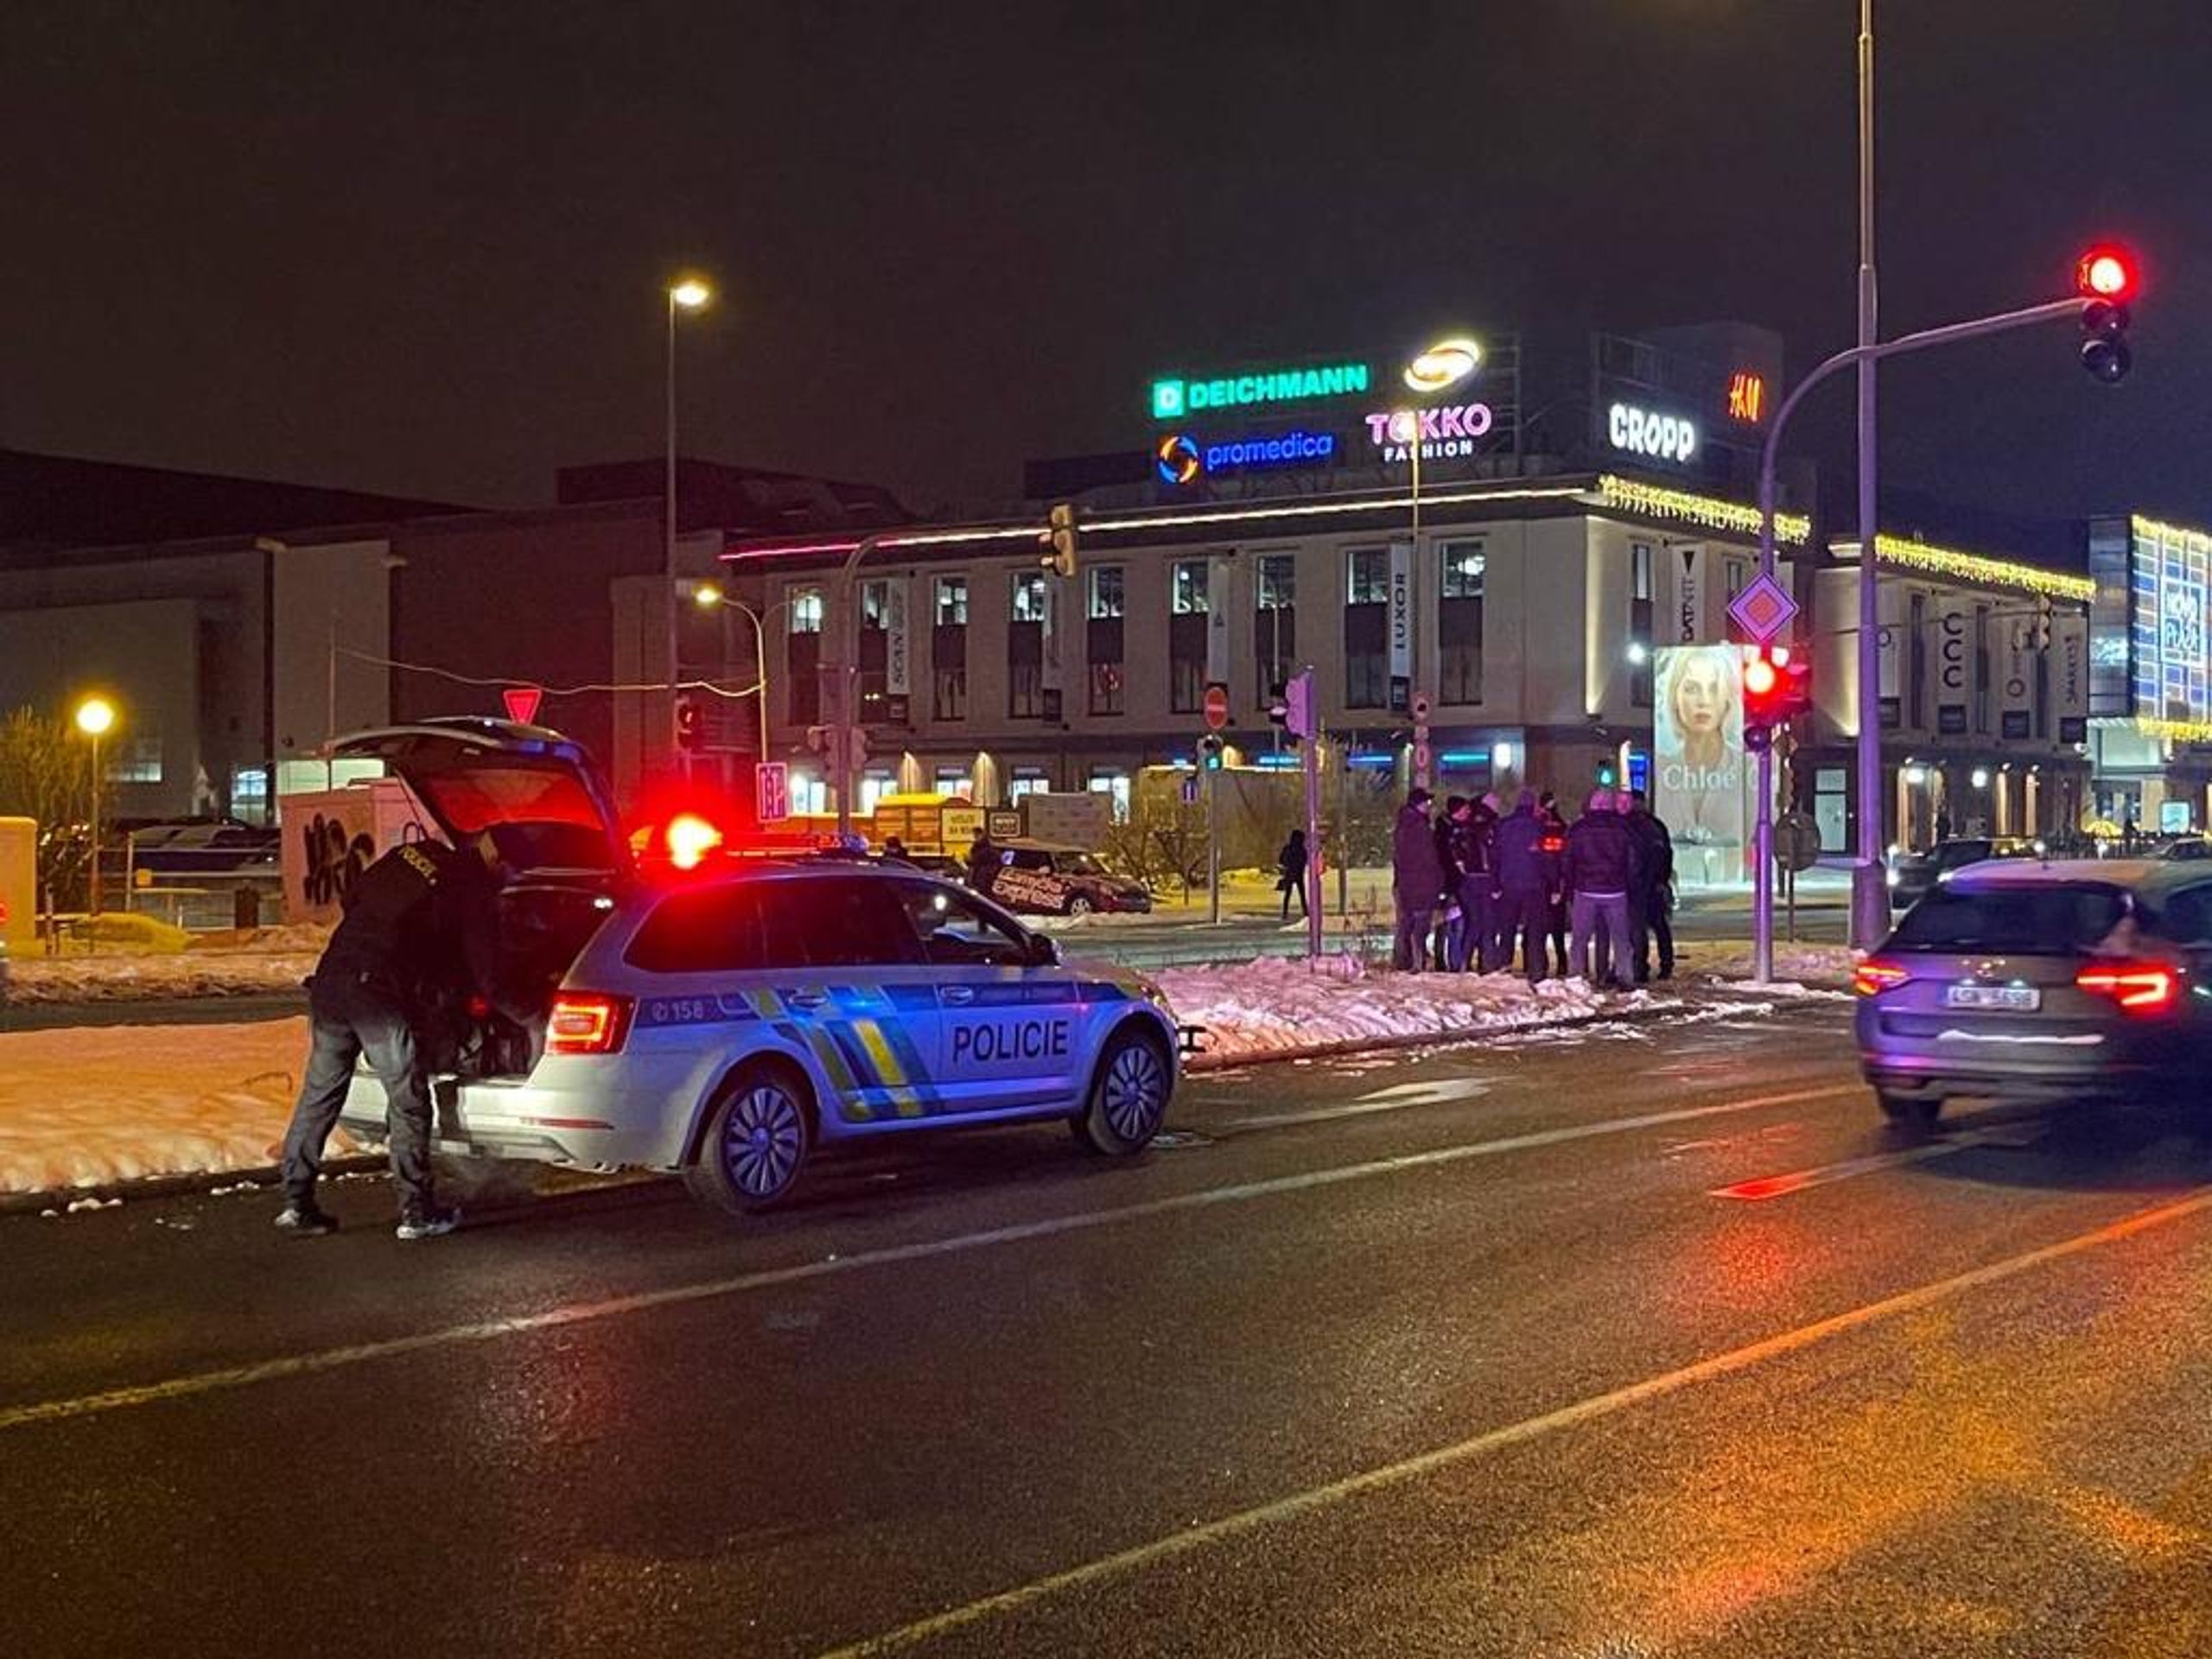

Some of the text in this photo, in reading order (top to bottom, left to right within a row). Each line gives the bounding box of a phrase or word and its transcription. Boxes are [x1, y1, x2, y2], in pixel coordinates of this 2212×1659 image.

[1189, 365, 1368, 409] DEICHMANN
[1364, 403, 1492, 445] TOKKO
[1609, 402, 1695, 463] CROPP
[1207, 433, 1333, 471] promedica
[1395, 574, 1406, 649] LUXOR
[1943, 612, 1963, 689] CCC
[672, 1000, 704, 1020] 158
[952, 1020, 1069, 1064] POLICIE
